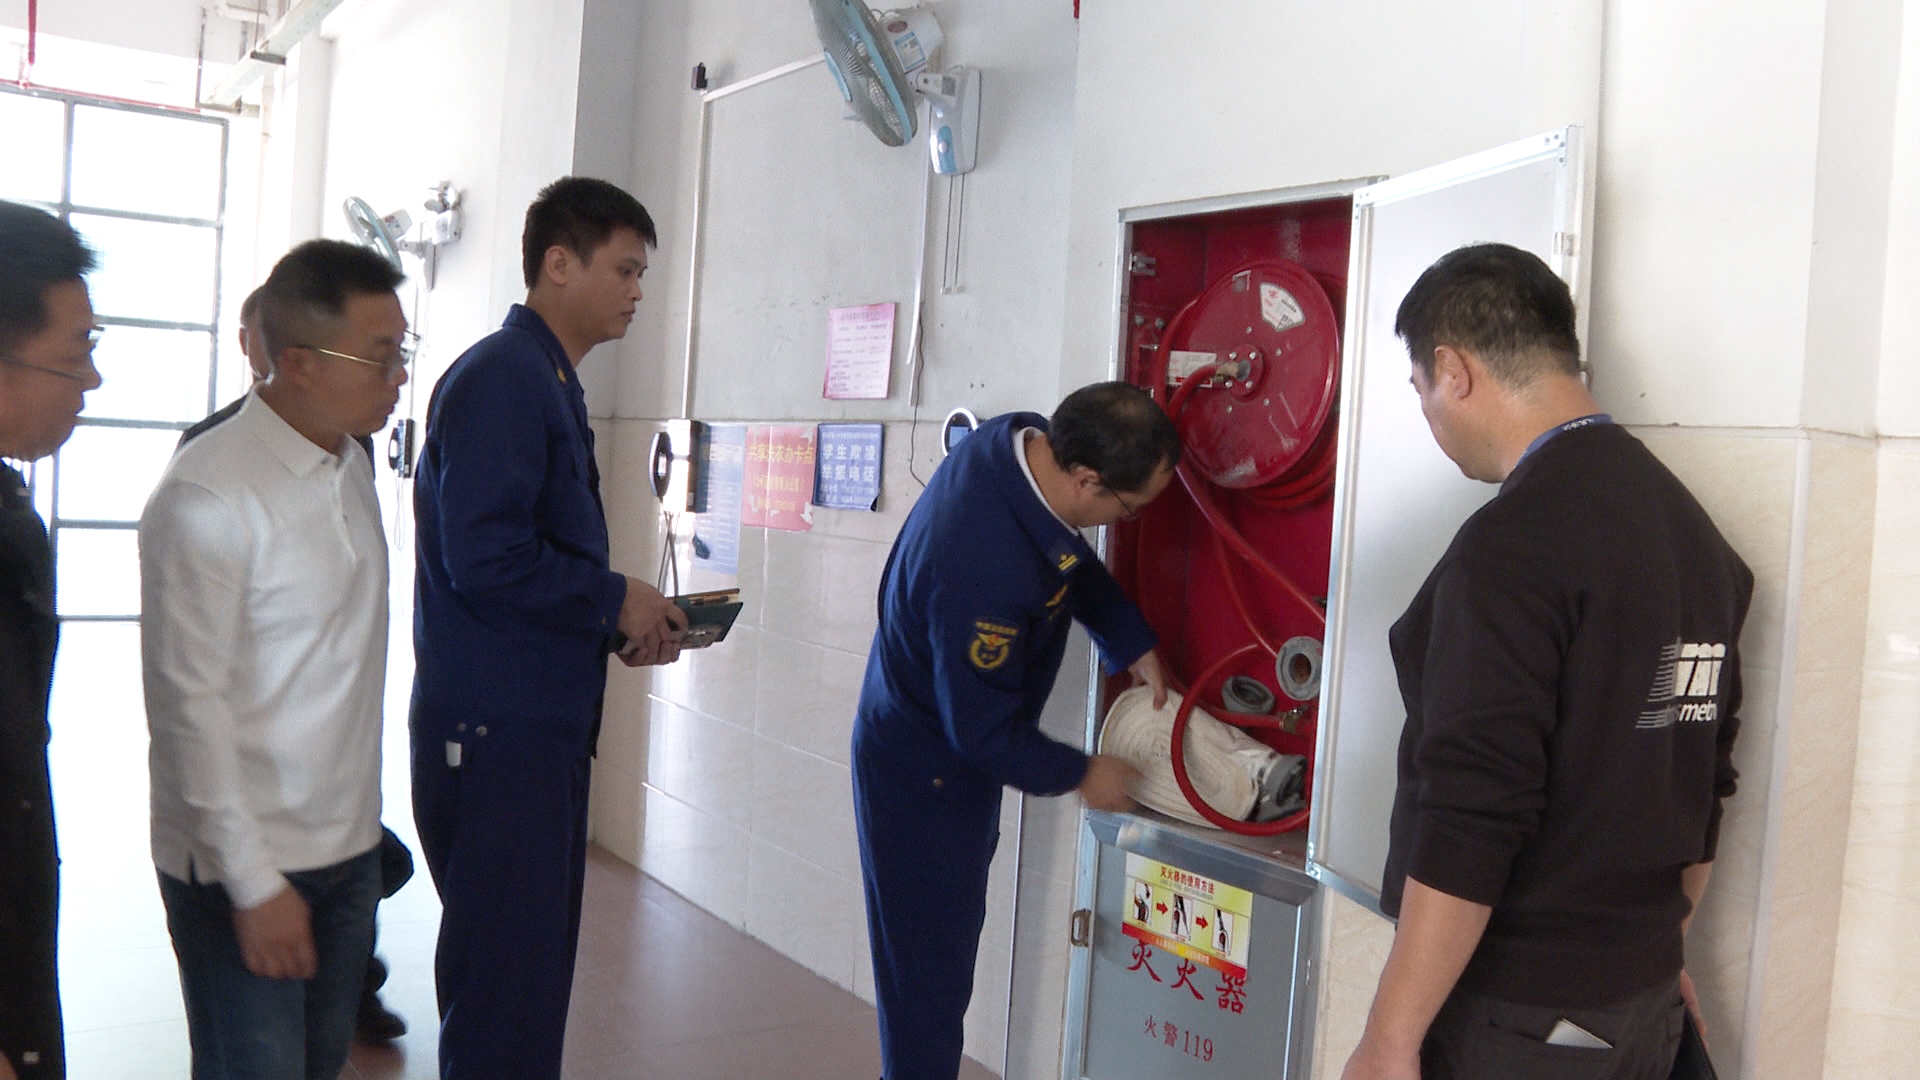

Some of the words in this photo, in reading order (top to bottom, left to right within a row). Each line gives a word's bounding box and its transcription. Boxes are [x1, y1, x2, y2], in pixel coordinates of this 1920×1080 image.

[822, 443, 876, 462] 学生欺凌
[821, 465, 875, 483] 举报电话
[1160, 866, 1215, 895] 灭火器的使用方法
[1126, 939, 1247, 1015] 灭火器
[1144, 1015, 1214, 1062] 火警119
